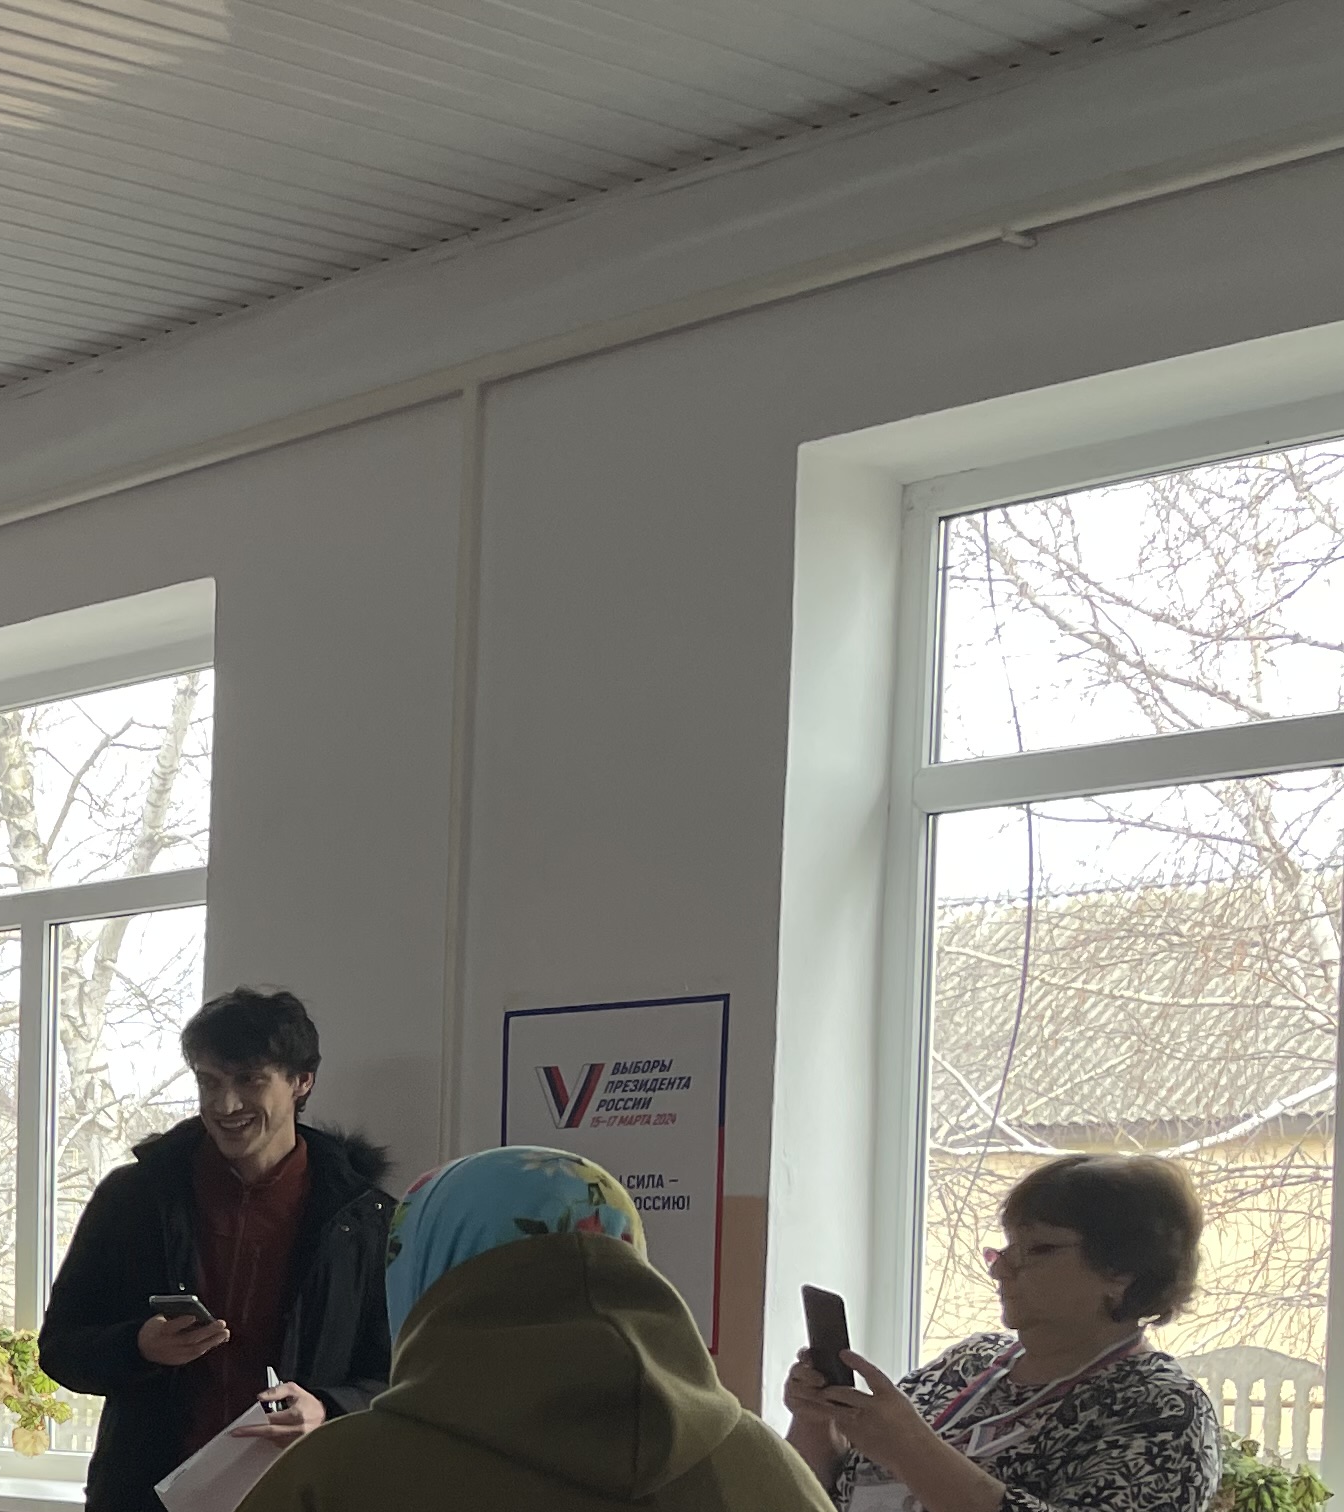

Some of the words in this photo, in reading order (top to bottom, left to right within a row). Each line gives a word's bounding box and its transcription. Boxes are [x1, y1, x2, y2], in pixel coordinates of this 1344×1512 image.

[610, 1059, 673, 1076] ВЫБОРЫ
[603, 1076, 692, 1094] ПРЕЗИДЕНТА
[596, 1097, 653, 1112] РОССИИ
[616, 1114, 652, 1127] МАРТА
[652, 1113, 677, 1126] 2024
[627, 1174, 664, 1190] СИЛА
[634, 1195, 691, 1211] ОССИЮ!
